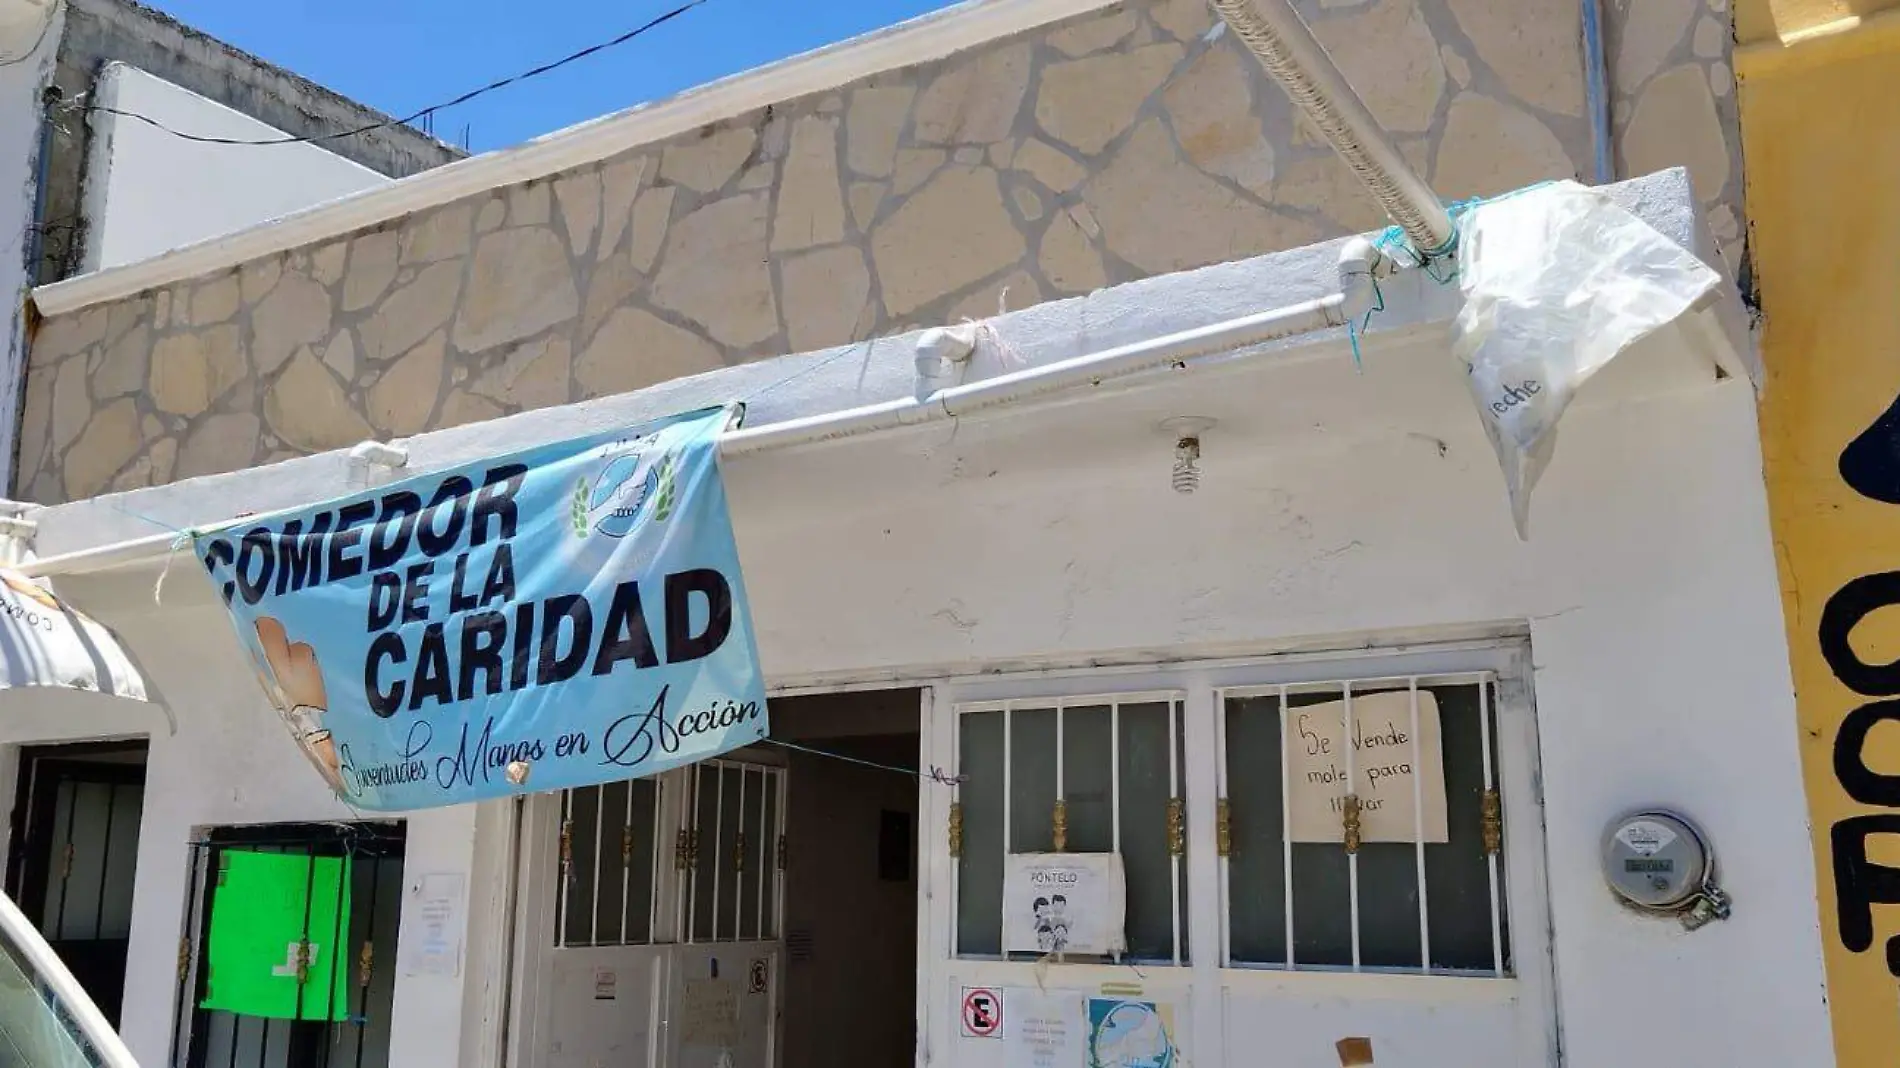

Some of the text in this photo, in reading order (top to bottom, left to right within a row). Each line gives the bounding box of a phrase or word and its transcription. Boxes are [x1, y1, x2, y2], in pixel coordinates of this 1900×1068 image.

[204, 463, 529, 608] COMEDOR
[368, 543, 517, 633] DE LA
[365, 568, 733, 718] CARIDAD
[341, 683, 760, 797] Juventudes Manos en Acción
[1298, 714, 1409, 755] Se Vende
[1366, 763, 1412, 791] para
[1330, 796, 1385, 813] llvar
